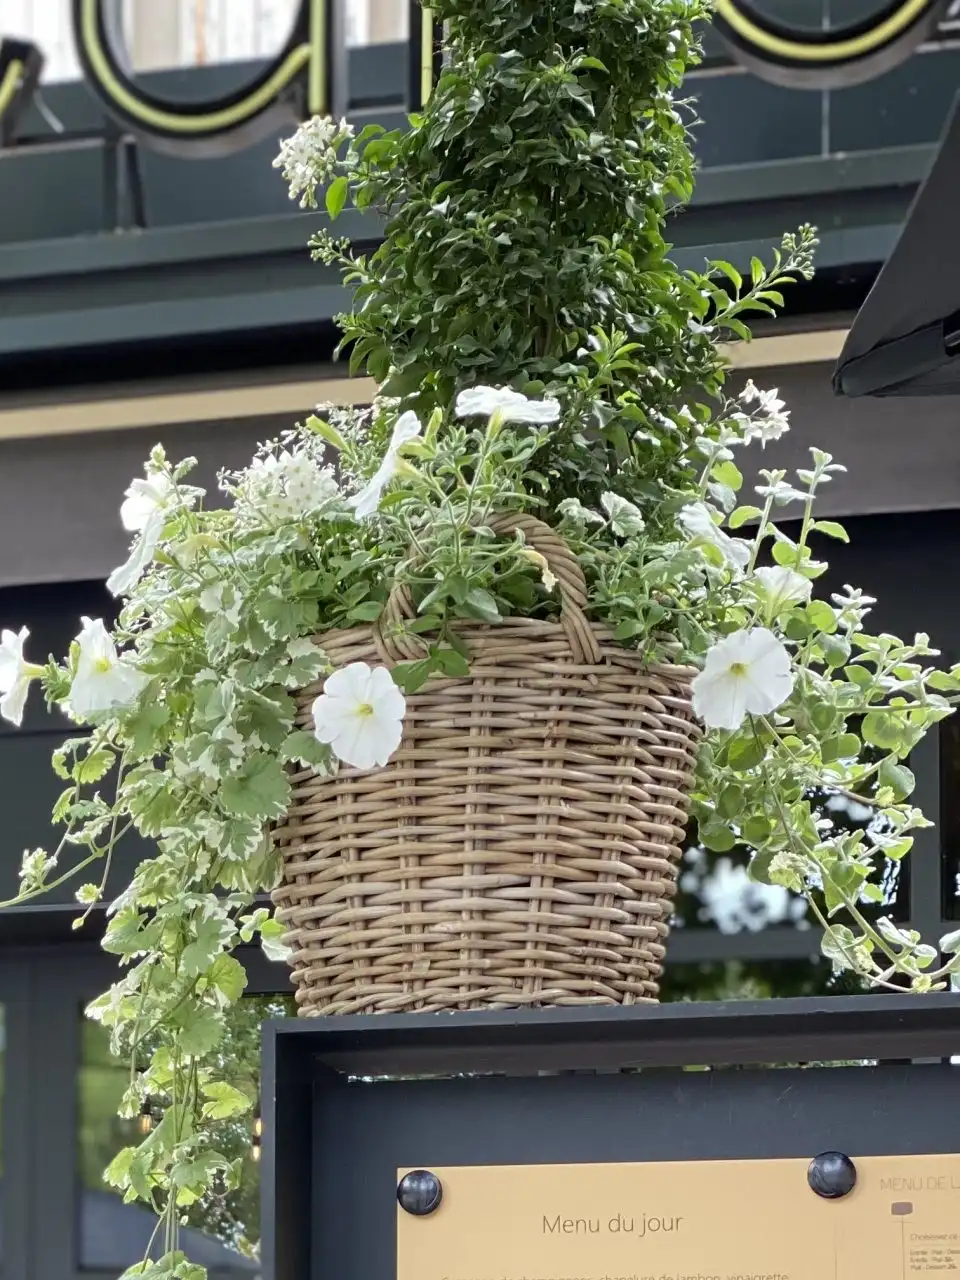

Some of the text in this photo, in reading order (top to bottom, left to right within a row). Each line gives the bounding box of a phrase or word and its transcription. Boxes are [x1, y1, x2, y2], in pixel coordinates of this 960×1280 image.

[541, 1212, 685, 1238] Menu du jour
